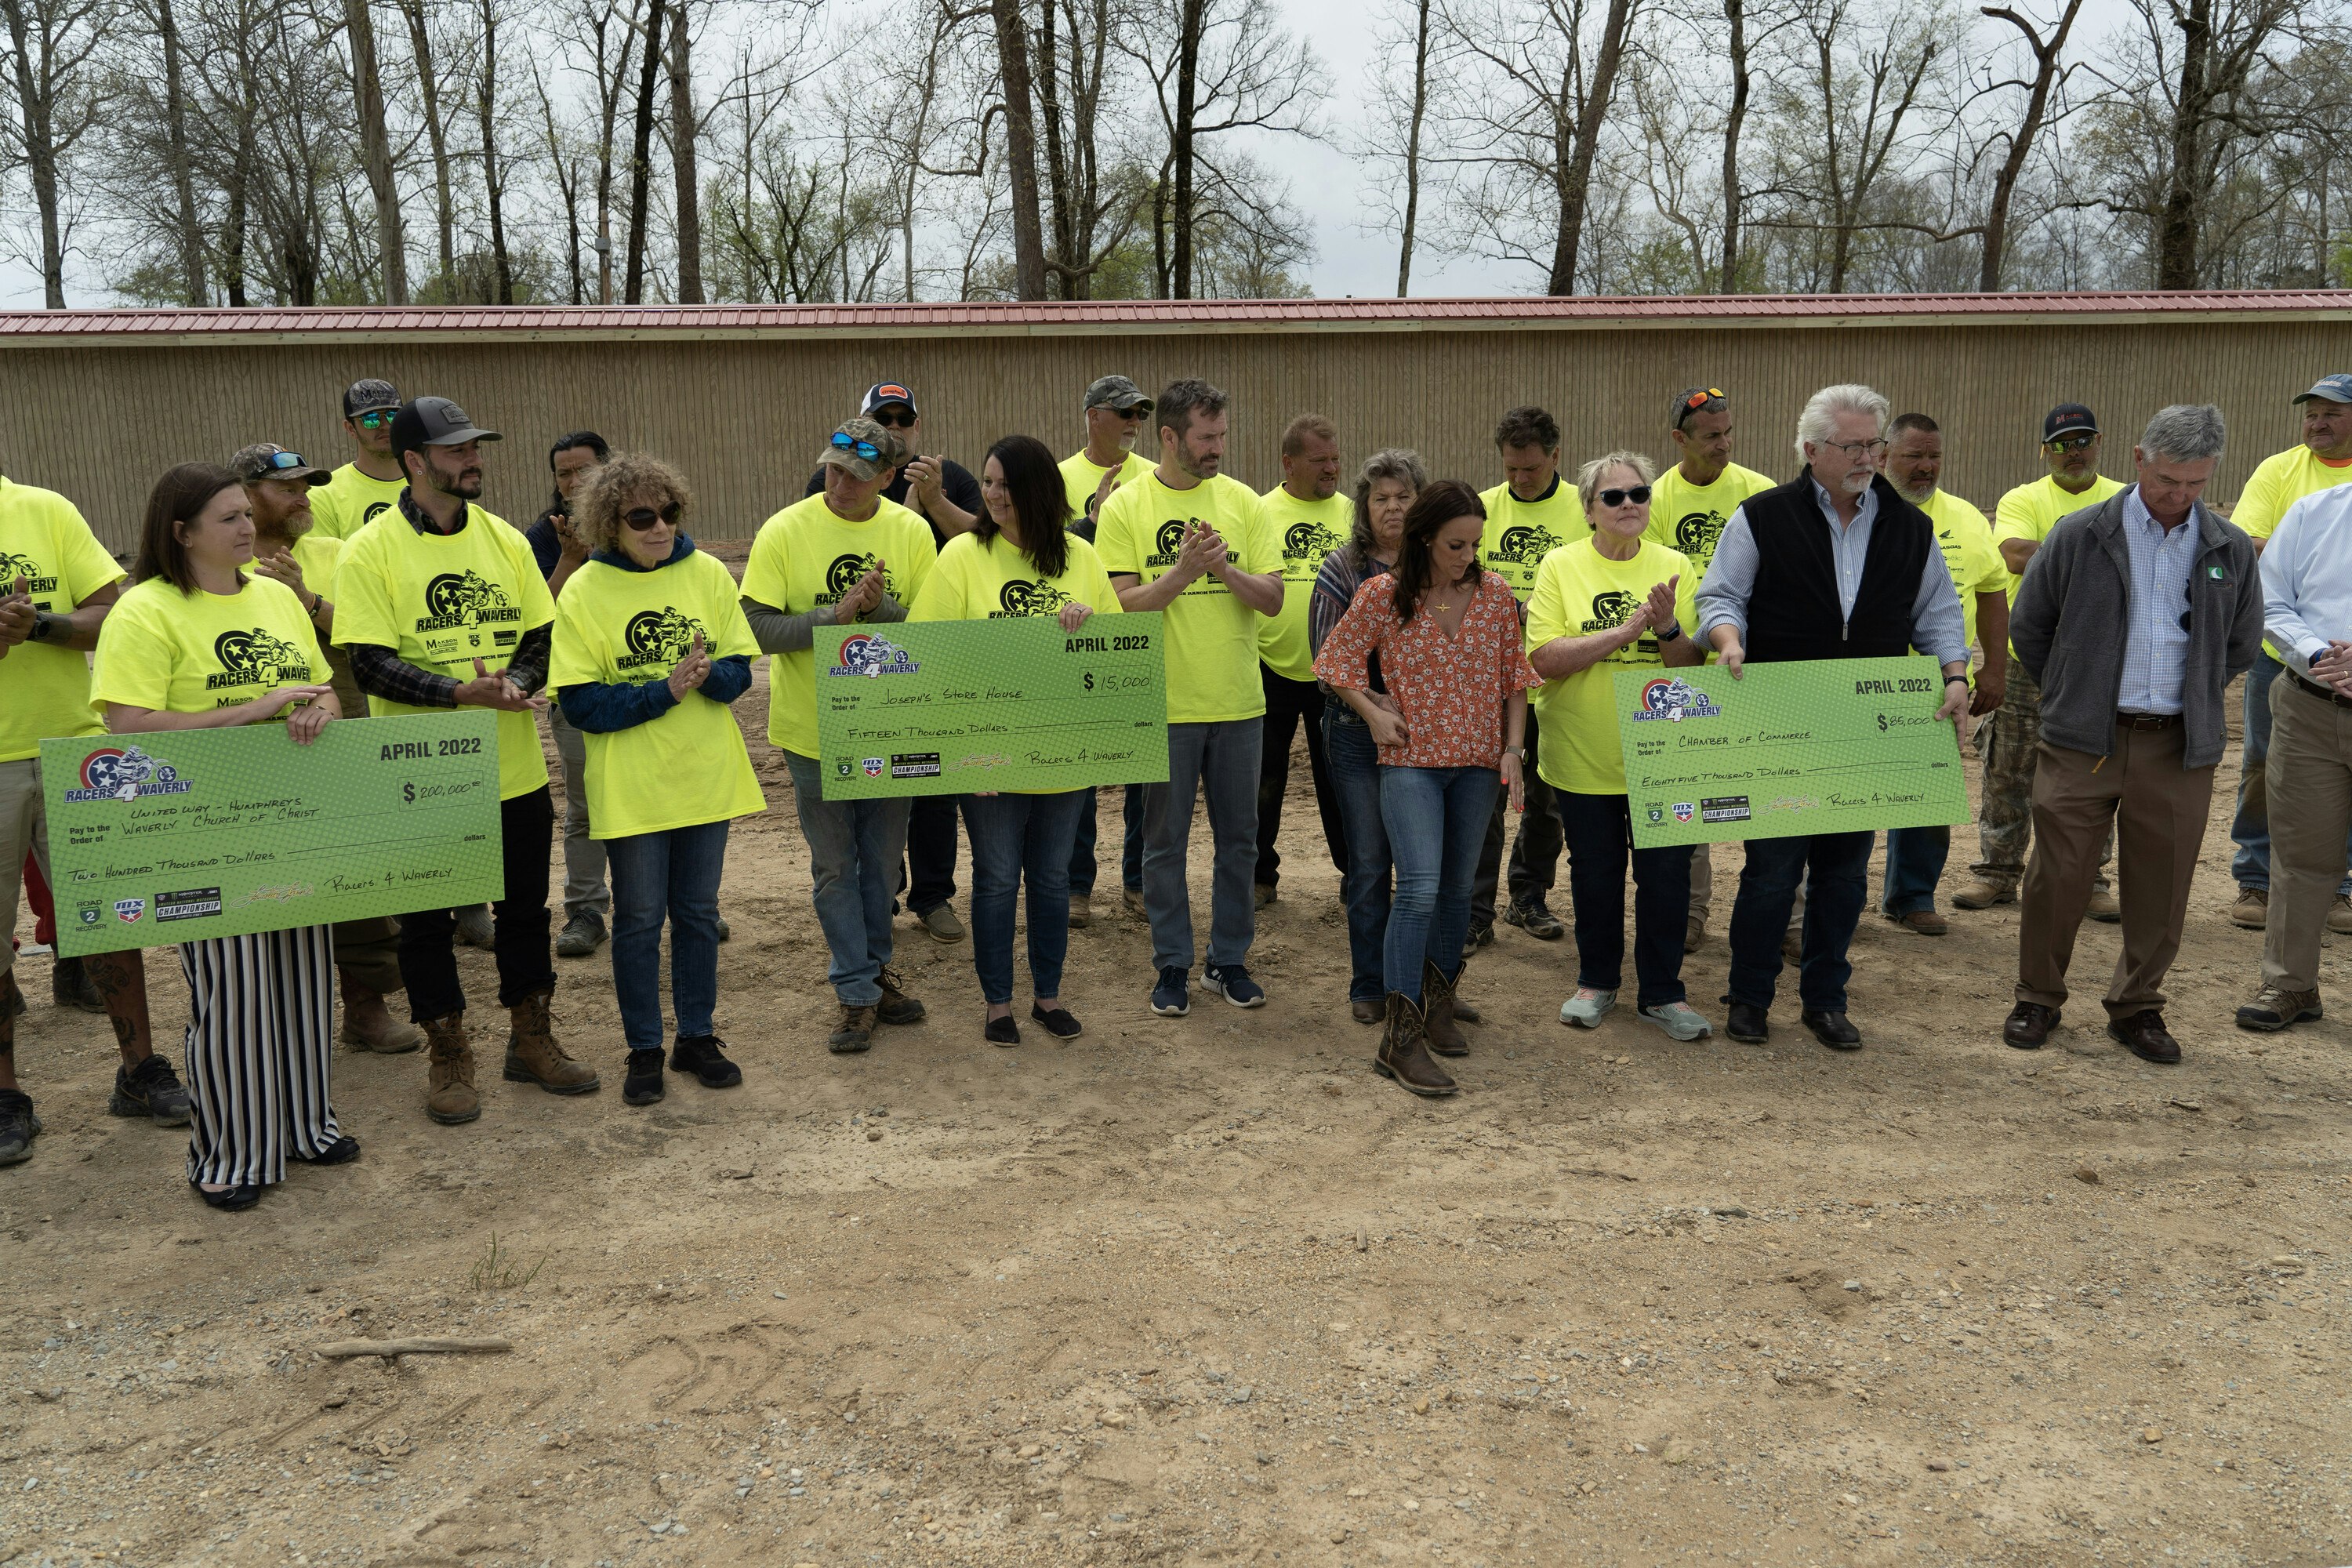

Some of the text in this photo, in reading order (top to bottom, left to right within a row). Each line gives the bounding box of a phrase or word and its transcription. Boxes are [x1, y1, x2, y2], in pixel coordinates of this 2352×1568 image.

[1283, 550, 1307, 560] ACERS
[1307, 548, 1323, 561] 4
[1668, 544, 1700, 554] ACERS
[1488, 551, 1522, 562] RACERS
[1521, 553, 1538, 568] 4
[0, 578, 57, 597] WERLY
[815, 593, 846, 604] RACE
[416, 608, 521, 632] RACERS 4 WAVERLY
[426, 638, 458, 650] MAKSON
[1065, 636, 1149, 653] APRIL 2022
[616, 651, 661, 670] RACERS
[661, 644, 681, 665] 4
[208, 665, 310, 688] RACERS 4 WAVER
[829, 662, 920, 678] RACERS 4 WAVERLY
[1083, 672, 1094, 691] $
[1101, 676, 1150, 692] 15,000
[1856, 678, 1933, 695] APRIL 2022
[217, 697, 253, 707] MAKSON
[880, 688, 931, 705] JOSEPH'S
[986, 687, 1023, 699] HOUSE
[1633, 706, 1721, 723] RACERS 4 WAVERLY
[1889, 715, 1930, 727] 85,000
[1877, 713, 1888, 732] $
[848, 728, 901, 739] FIFTEEN
[1679, 735, 1729, 748] CHAMBER
[1759, 731, 1811, 742] COMMERCE
[380, 737, 481, 761] APRIL 2022
[1078, 748, 1088, 763] 4
[1094, 750, 1134, 760] WAVERLY
[842, 765, 848, 774] 2
[893, 765, 938, 774] CHAMPIONSHIP
[65, 781, 192, 803] RACERS 4 WAVERLY
[403, 781, 416, 804] $
[1871, 792, 1882, 804] 4
[1886, 793, 1925, 804] WAVERLY
[131, 808, 178, 819] UNITED
[182, 804, 210, 814] WAY
[230, 798, 302, 811] HUMPHREYS
[1653, 811, 1659, 819] 2
[1704, 808, 1748, 818] CHAMPIONSHIP
[122, 820, 178, 835] WAVERLY
[71, 837, 94, 845] Order
[105, 864, 153, 879] HUNDRED
[385, 872, 394, 886] 4
[402, 868, 453, 882] WAVERLY
[86, 911, 96, 921] 2
[158, 902, 219, 916] CHAMPIONSHIP
[76, 924, 107, 932] RECOVERY
